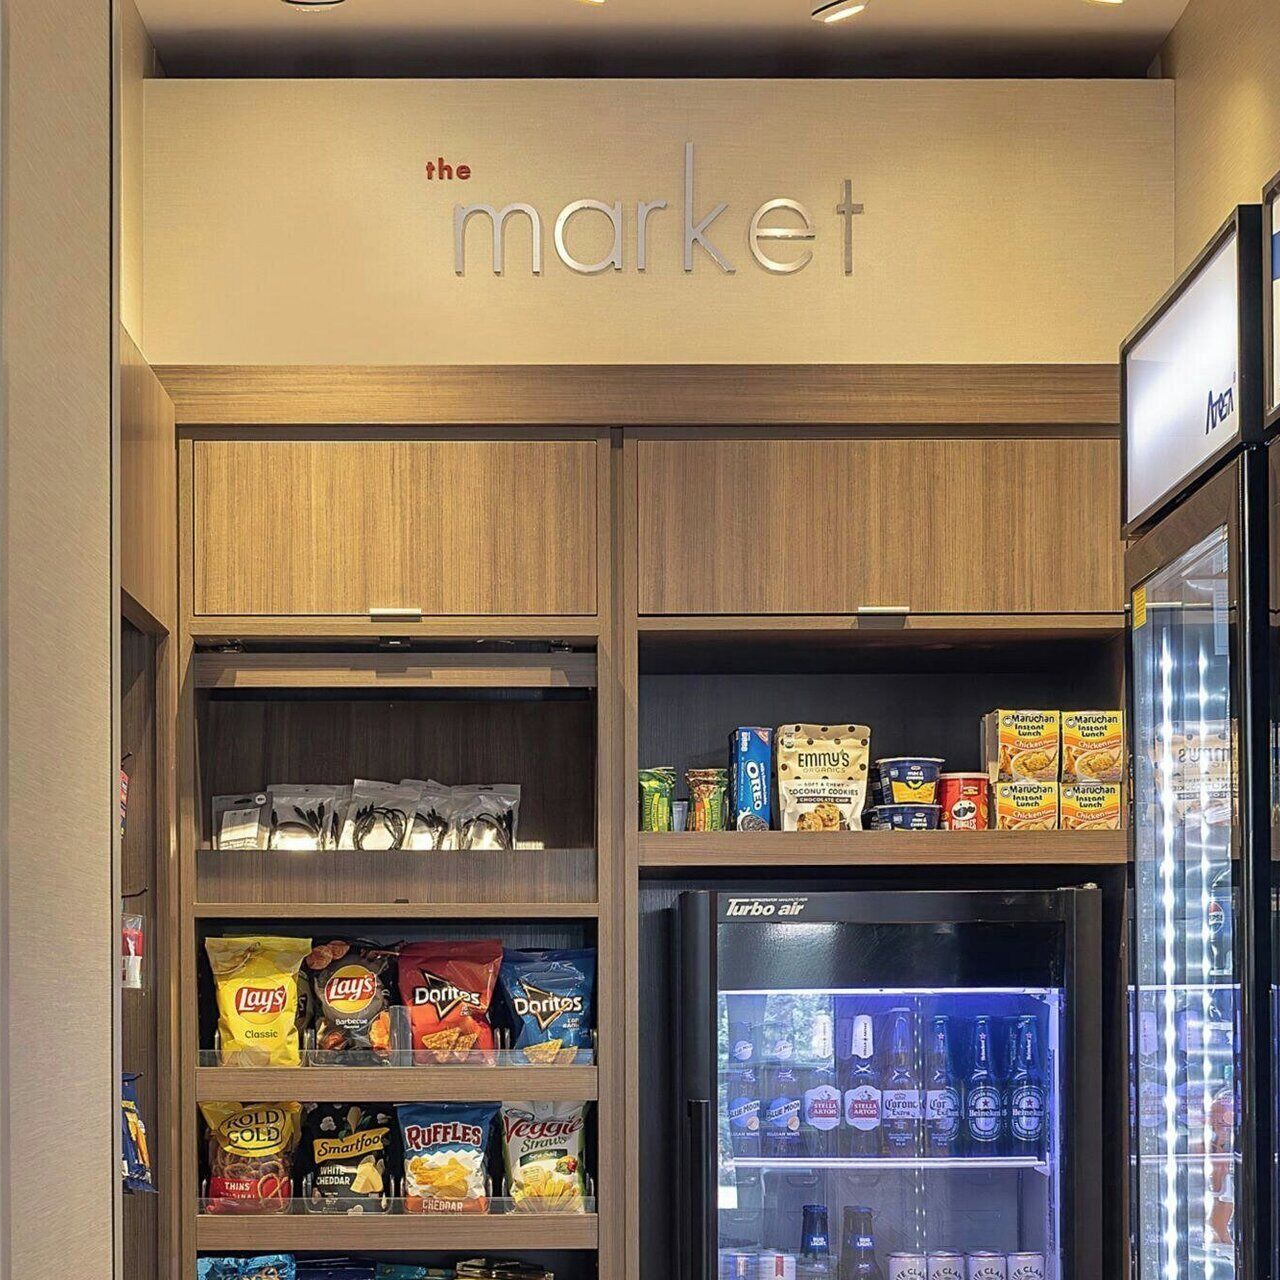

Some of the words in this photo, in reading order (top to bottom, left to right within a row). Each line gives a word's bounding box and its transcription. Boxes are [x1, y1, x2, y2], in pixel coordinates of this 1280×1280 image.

[425, 157, 471, 180] the
[454, 141, 864, 275] market
[1012, 715, 1054, 723] Maruchan
[746, 760, 762, 810] OREO
[828, 788, 858, 796] COOKIES
[1073, 786, 1115, 794] Maruchan
[726, 898, 775, 916] Turbo
[778, 901, 804, 915] air
[329, 974, 375, 1003] Lay's
[415, 985, 480, 1006] Doritos
[238, 985, 286, 1014] Lay's
[514, 993, 582, 1015] Doritos
[335, 1018, 368, 1026] Barbecue
[245, 1029, 278, 1039] Classic
[227, 1110, 279, 1129] ROLD
[969, 1109, 1000, 1117] Heineken
[227, 1126, 280, 1144] GOLD
[406, 1122, 482, 1150] RUFFLES
[503, 1115, 584, 1144] Veggie
[318, 1134, 383, 1156] Smartfoo
[521, 1136, 568, 1152] Straws
[320, 1166, 345, 1175] WHITE
[225, 1182, 250, 1191] THINS
[317, 1176, 350, 1185] CHEDDAR
[422, 1200, 463, 1212] CHEDDAR
